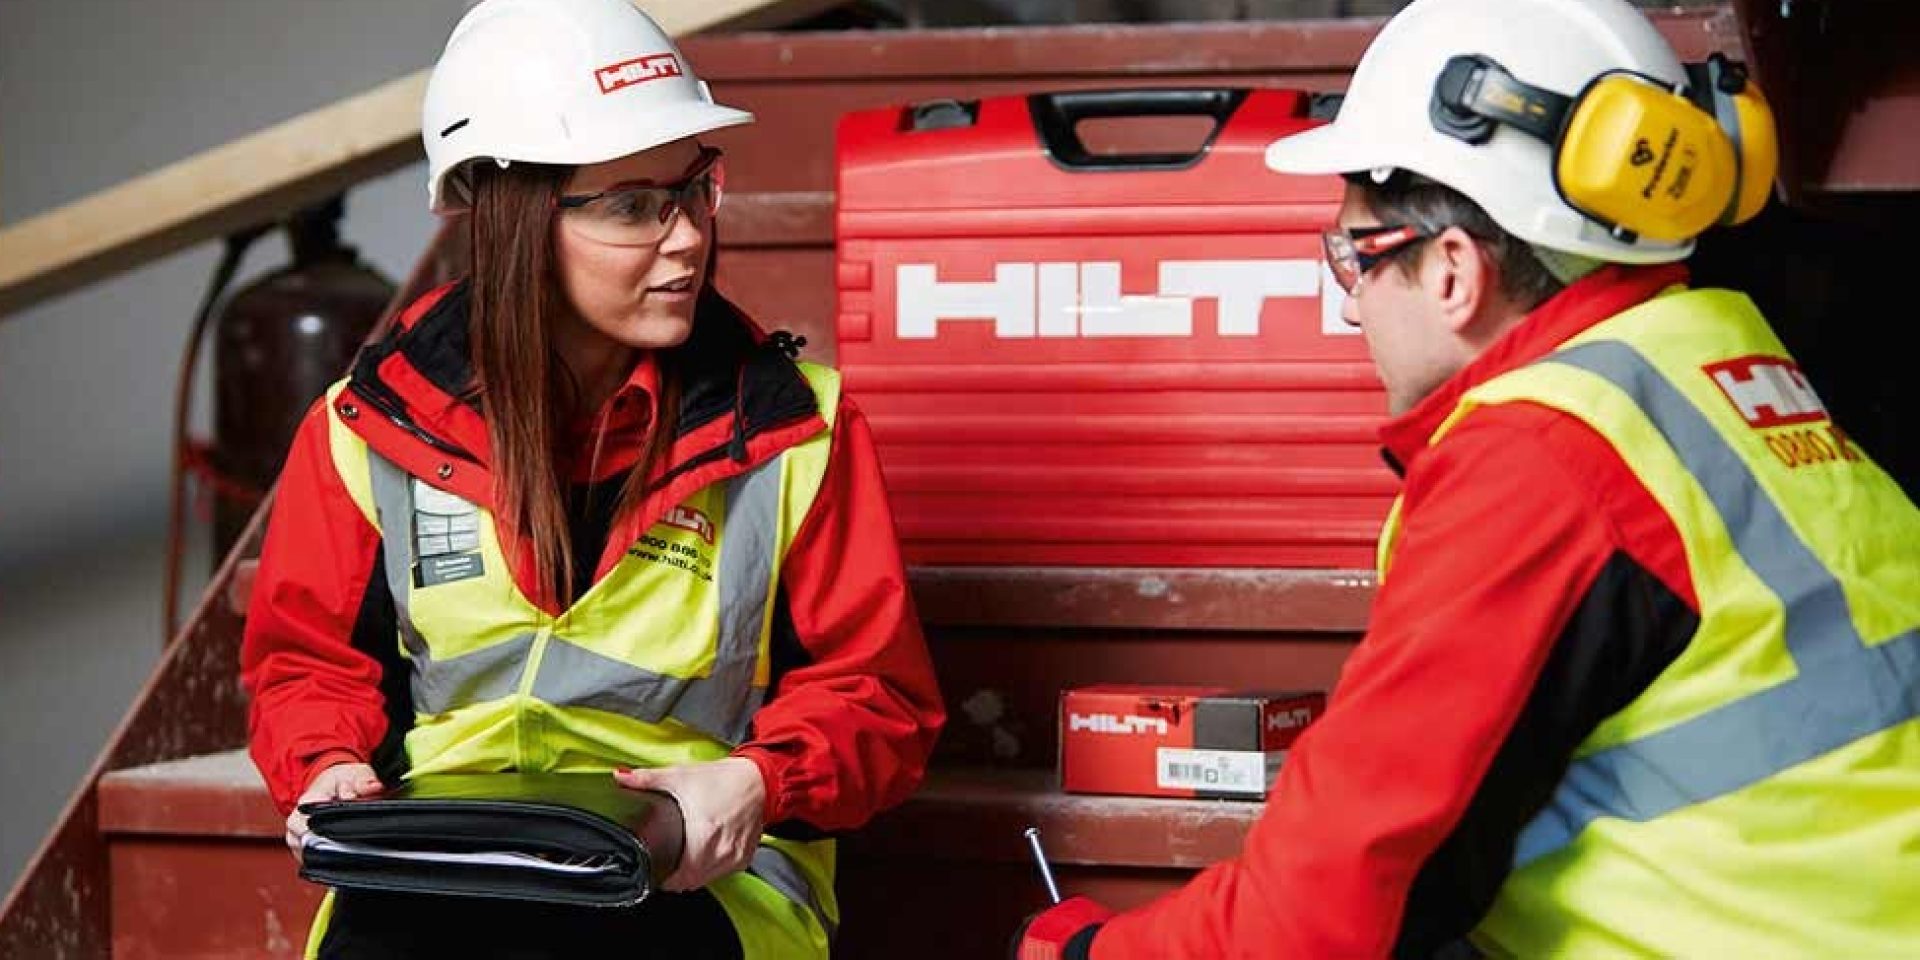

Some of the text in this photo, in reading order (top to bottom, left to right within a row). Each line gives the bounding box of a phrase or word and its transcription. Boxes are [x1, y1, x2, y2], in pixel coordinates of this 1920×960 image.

[599, 60, 680, 91] HILTI
[897, 261, 1362, 337] HILTI
[1714, 364, 1827, 421] HIL
[664, 508, 714, 541] ILTI
[638, 533, 667, 550] 800
[1070, 713, 1167, 734] HILTI
[1267, 708, 1311, 731] HILTI
